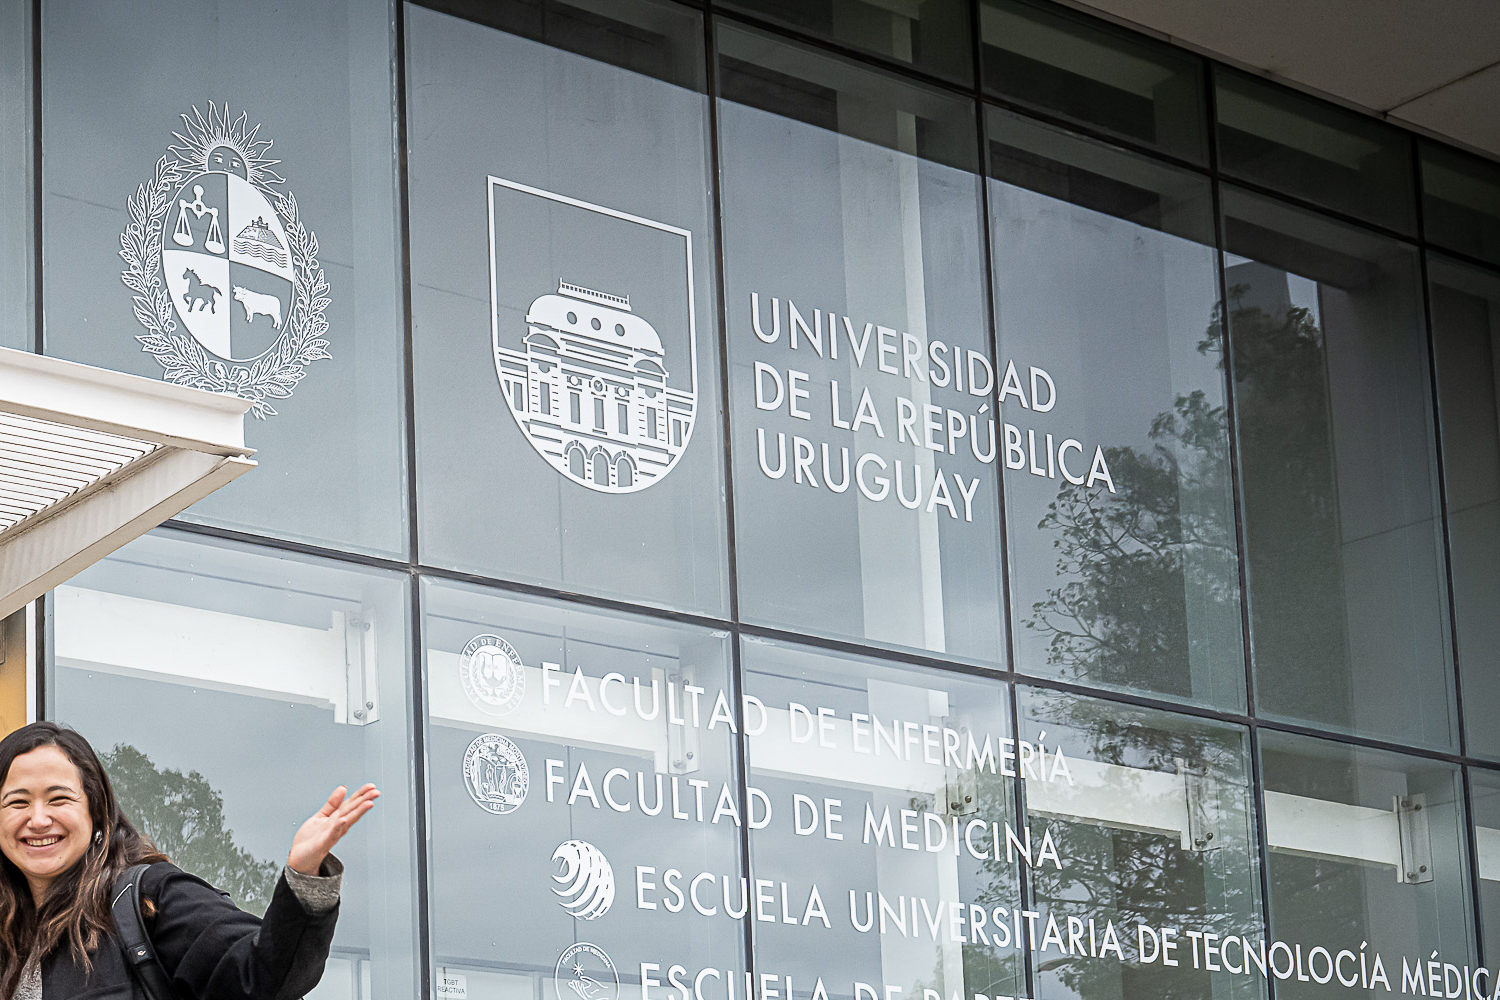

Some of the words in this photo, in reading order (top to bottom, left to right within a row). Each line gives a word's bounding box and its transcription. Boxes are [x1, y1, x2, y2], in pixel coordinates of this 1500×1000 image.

[751, 292, 1057, 413] UNIVERSIDAD
[754, 360, 811, 420] DE
[830, 379, 885, 439] LA
[896, 403, 1117, 494] REPÚBLICA
[757, 428, 980, 522] URUGUAY
[542, 661, 769, 737] FACULTAD
[788, 702, 837, 748] DE
[851, 712, 1074, 787] ENFERMERÍA
[545, 759, 773, 831] FACULTAD
[793, 793, 844, 841] DE
[863, 801, 1064, 871] MEDICINA
[635, 865, 832, 929] ESCUELA
[849, 889, 1126, 962] UNIVERSITARIA
[1138, 923, 1180, 967] DE
